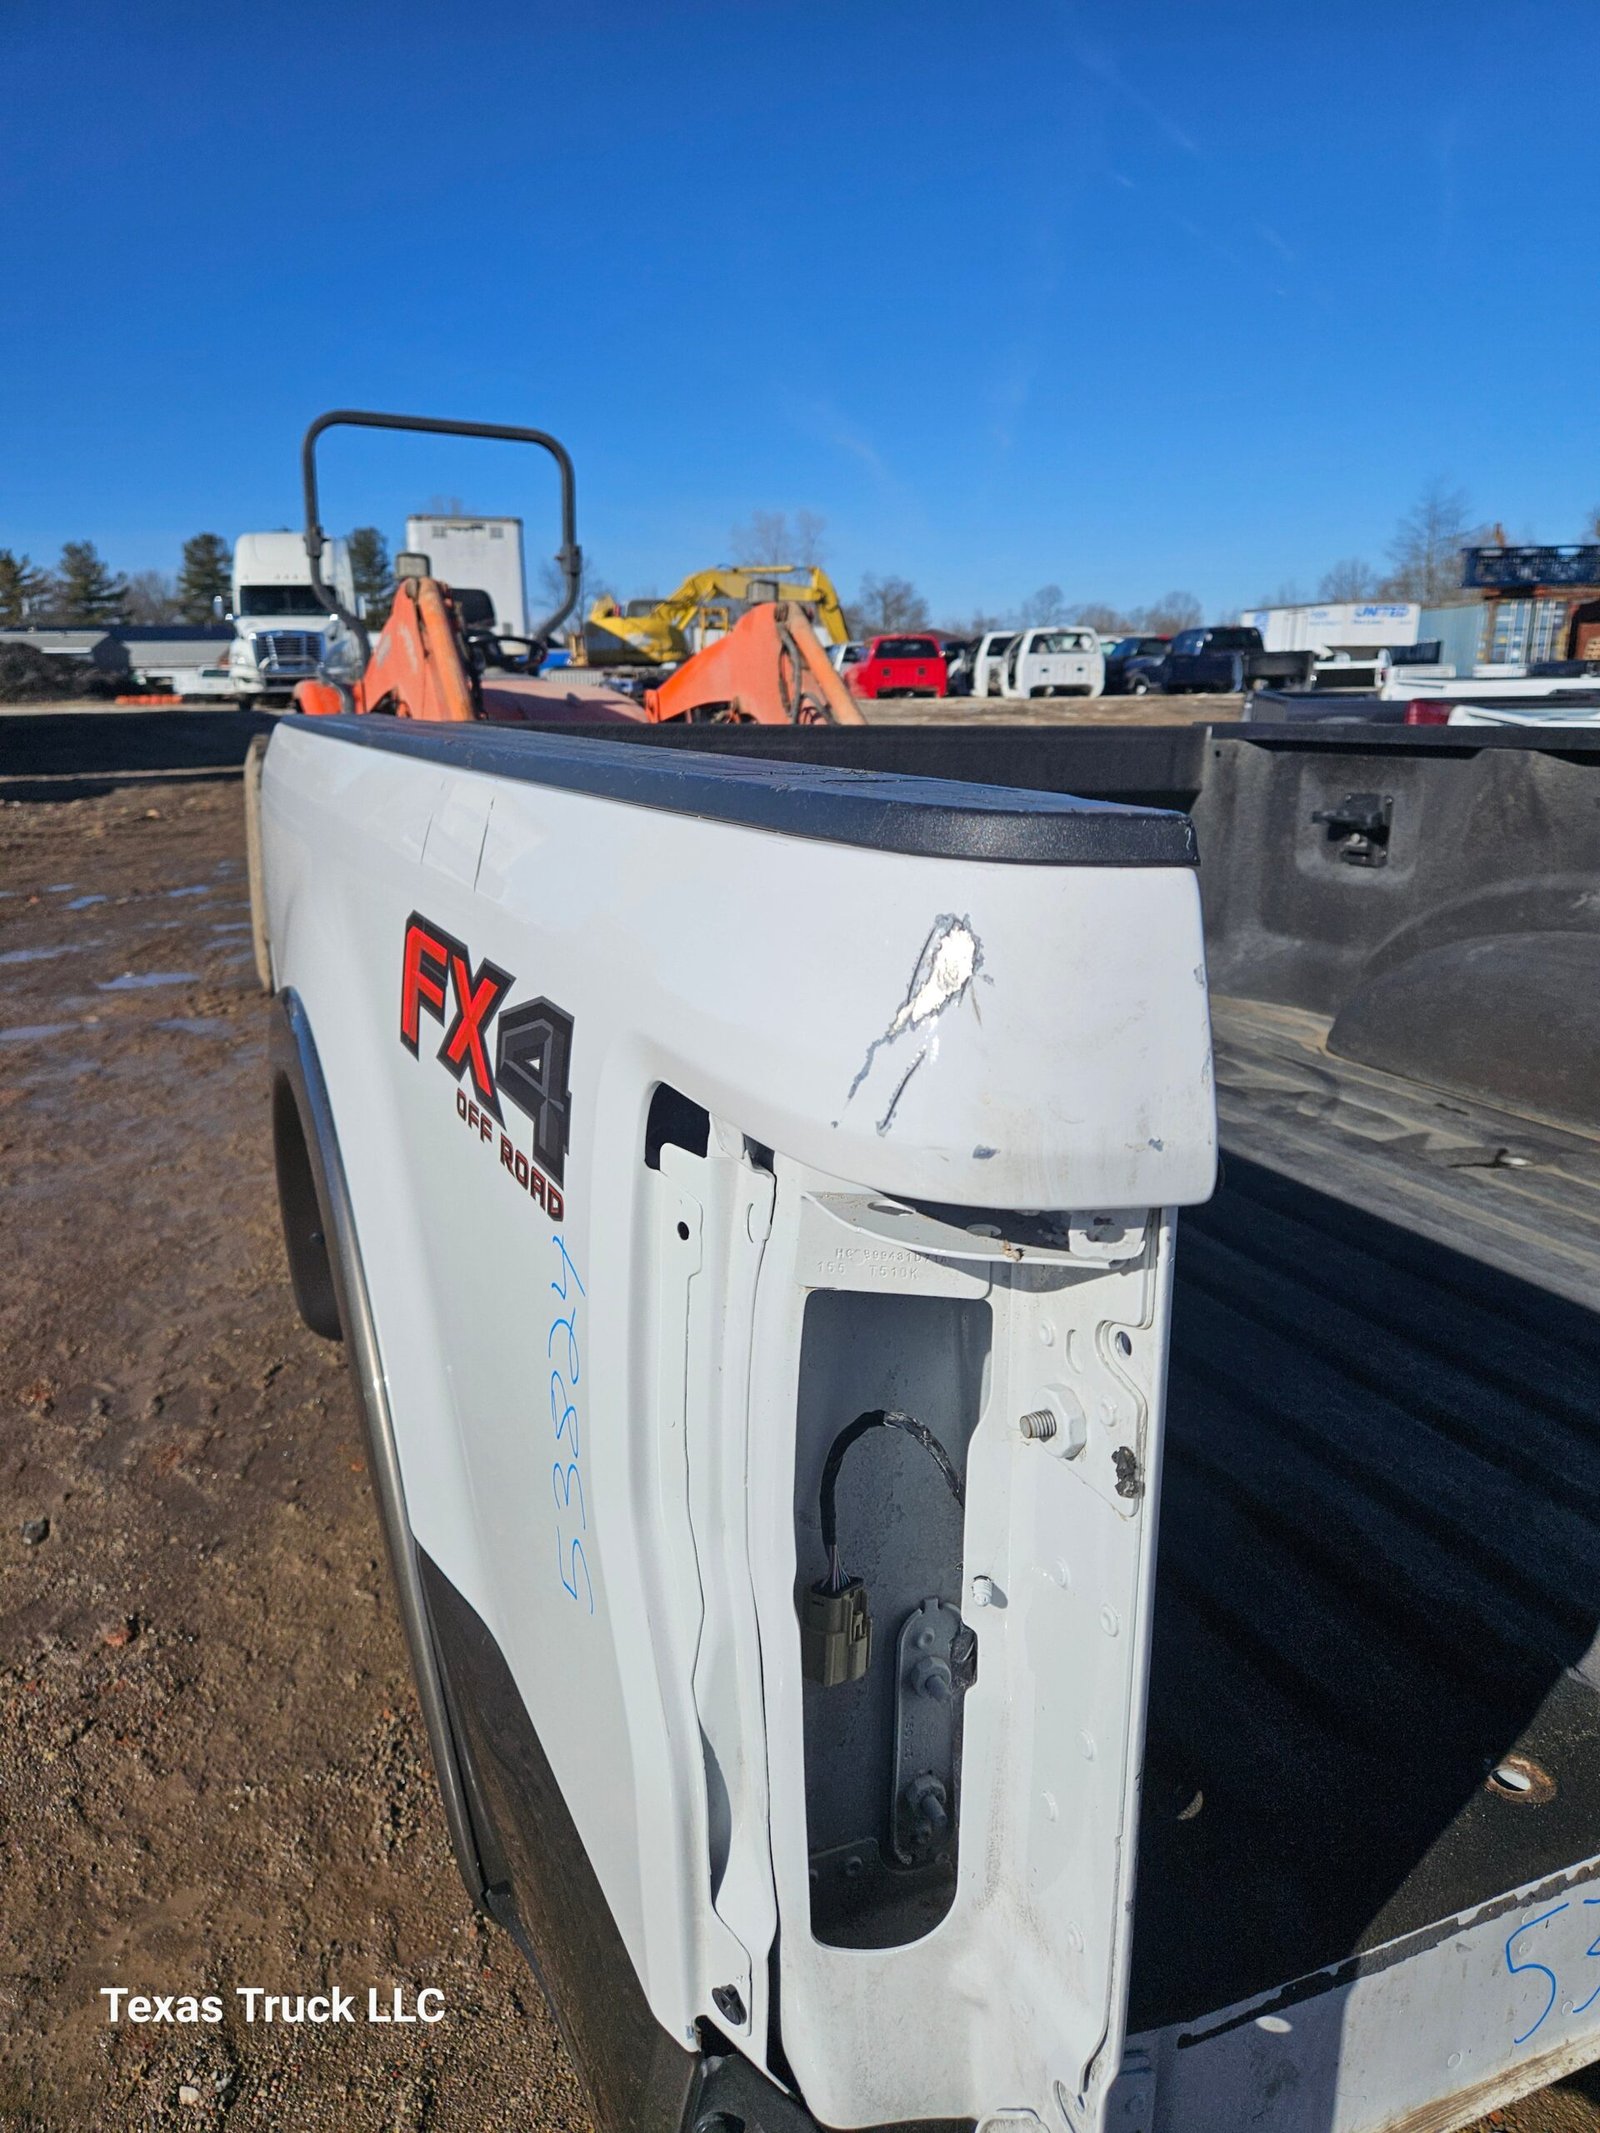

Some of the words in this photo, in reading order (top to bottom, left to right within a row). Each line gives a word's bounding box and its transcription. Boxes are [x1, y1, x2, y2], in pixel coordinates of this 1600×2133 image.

[400, 909, 575, 1191] FX4
[456, 1088, 493, 1143] OFF
[500, 1132, 563, 1222] ROAD
[548, 1235, 593, 1615] 53824
